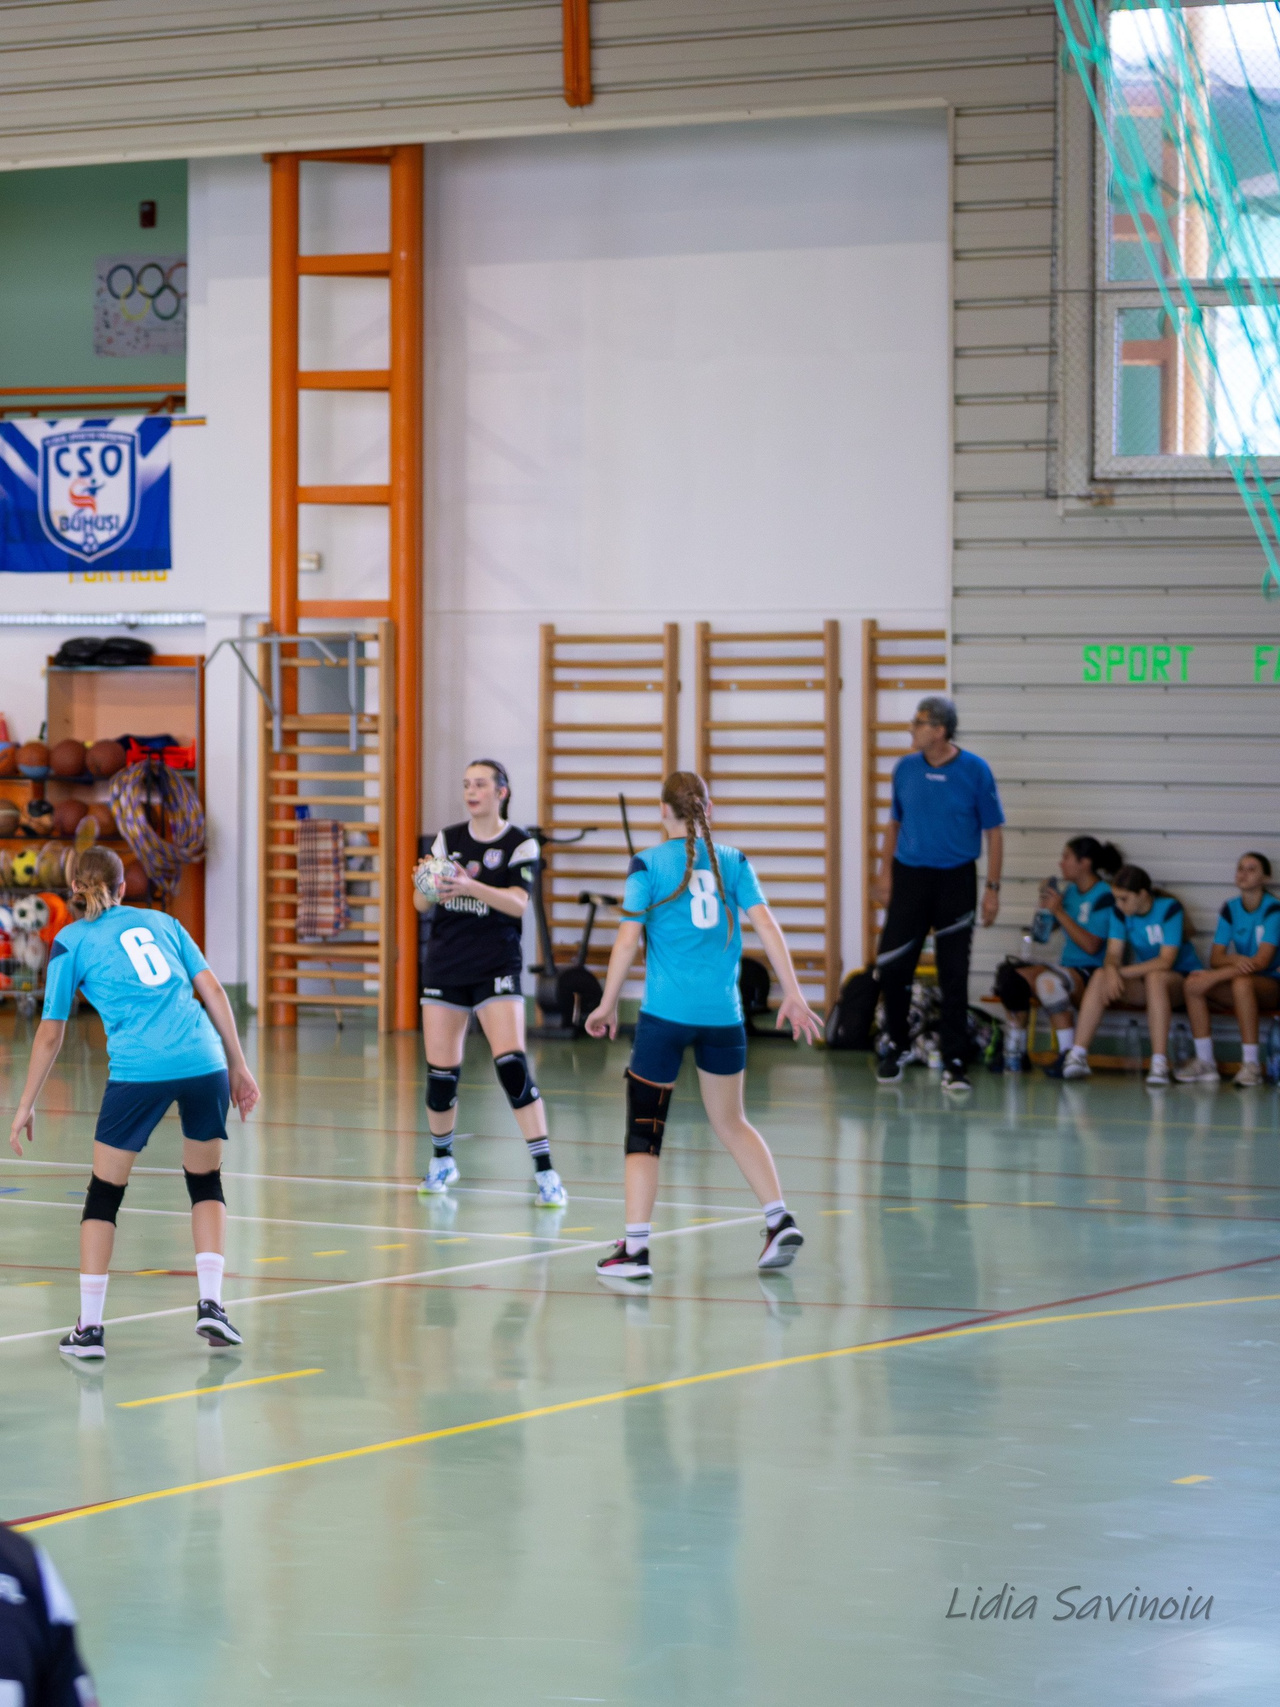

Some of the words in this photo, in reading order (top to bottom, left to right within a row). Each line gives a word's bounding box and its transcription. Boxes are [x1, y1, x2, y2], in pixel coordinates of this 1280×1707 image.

[54, 444, 122, 478] CSO
[1083, 644, 1194, 682] SPORT
[688, 869, 719, 929] 8
[120, 926, 172, 987] 6
